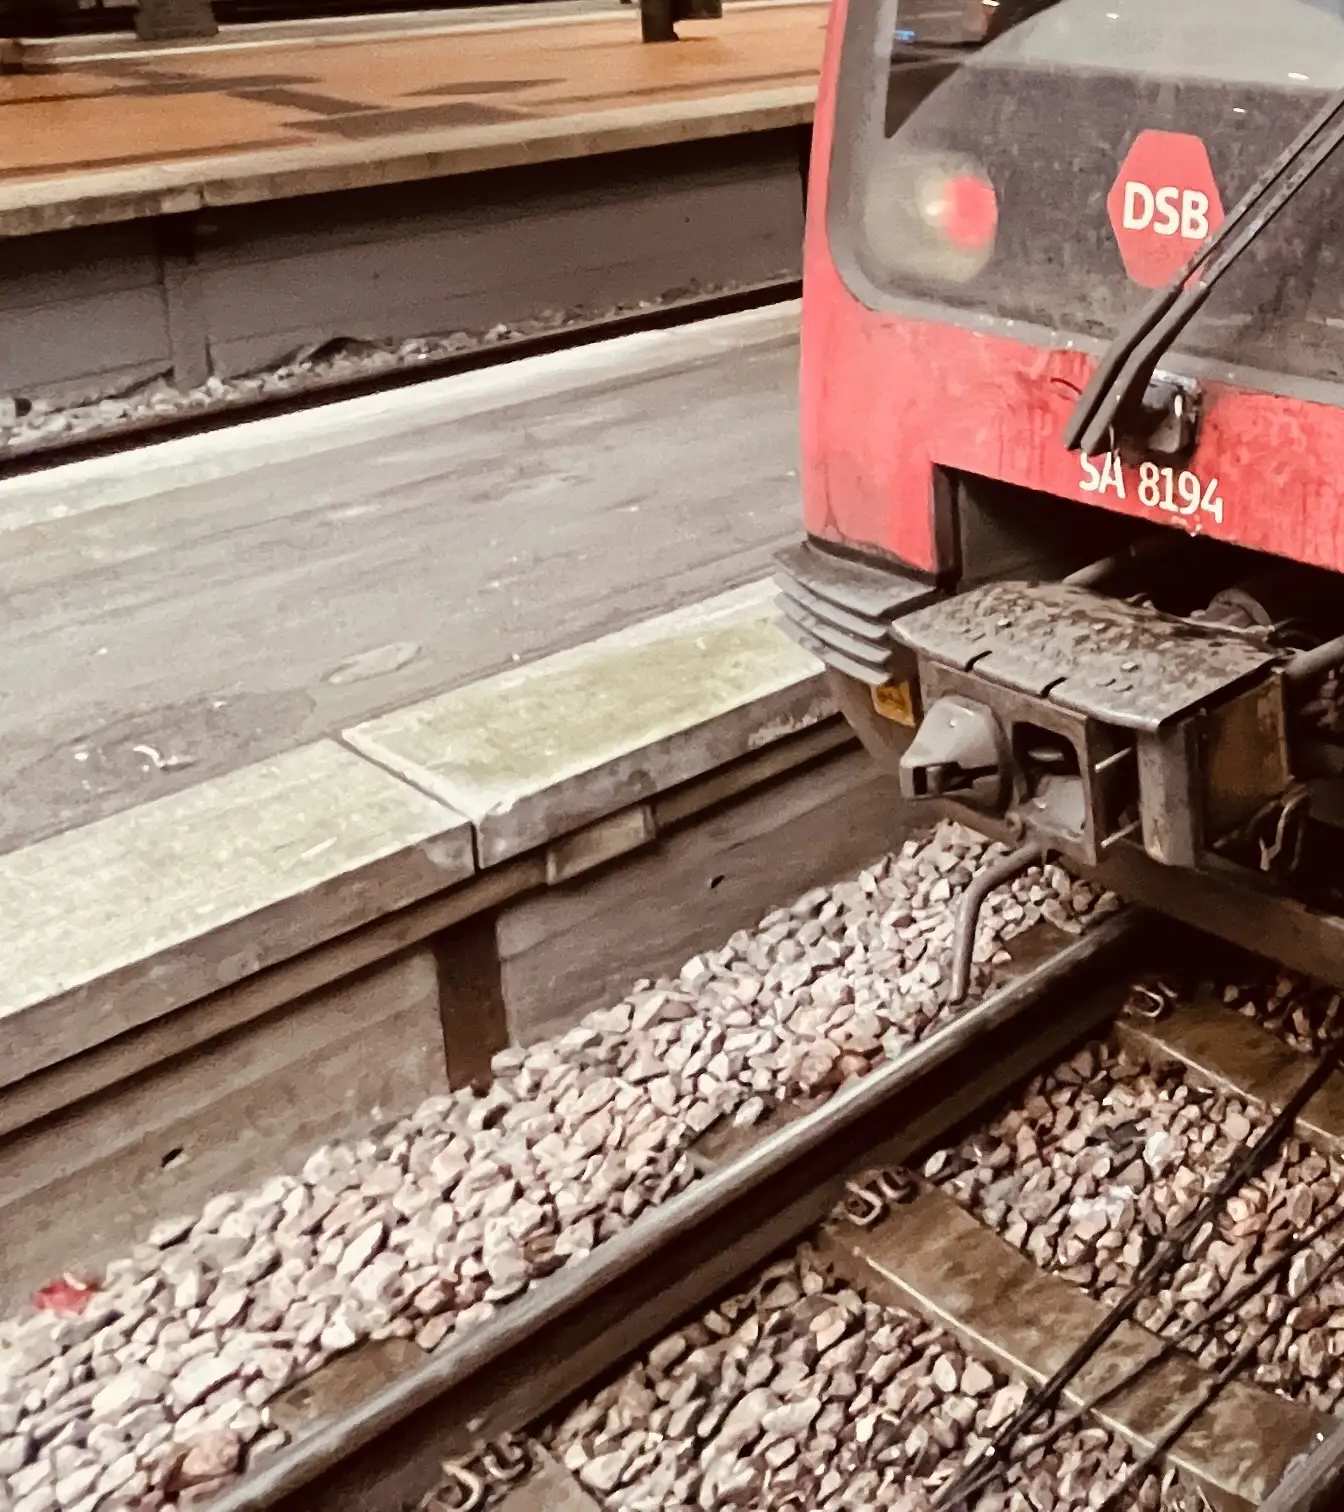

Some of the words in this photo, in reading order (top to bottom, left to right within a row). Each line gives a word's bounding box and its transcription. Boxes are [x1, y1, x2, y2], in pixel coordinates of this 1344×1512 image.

[1123, 181, 1209, 240] DSB
[1079, 451, 1126, 499] SA
[1138, 462, 1223, 524] 8194
